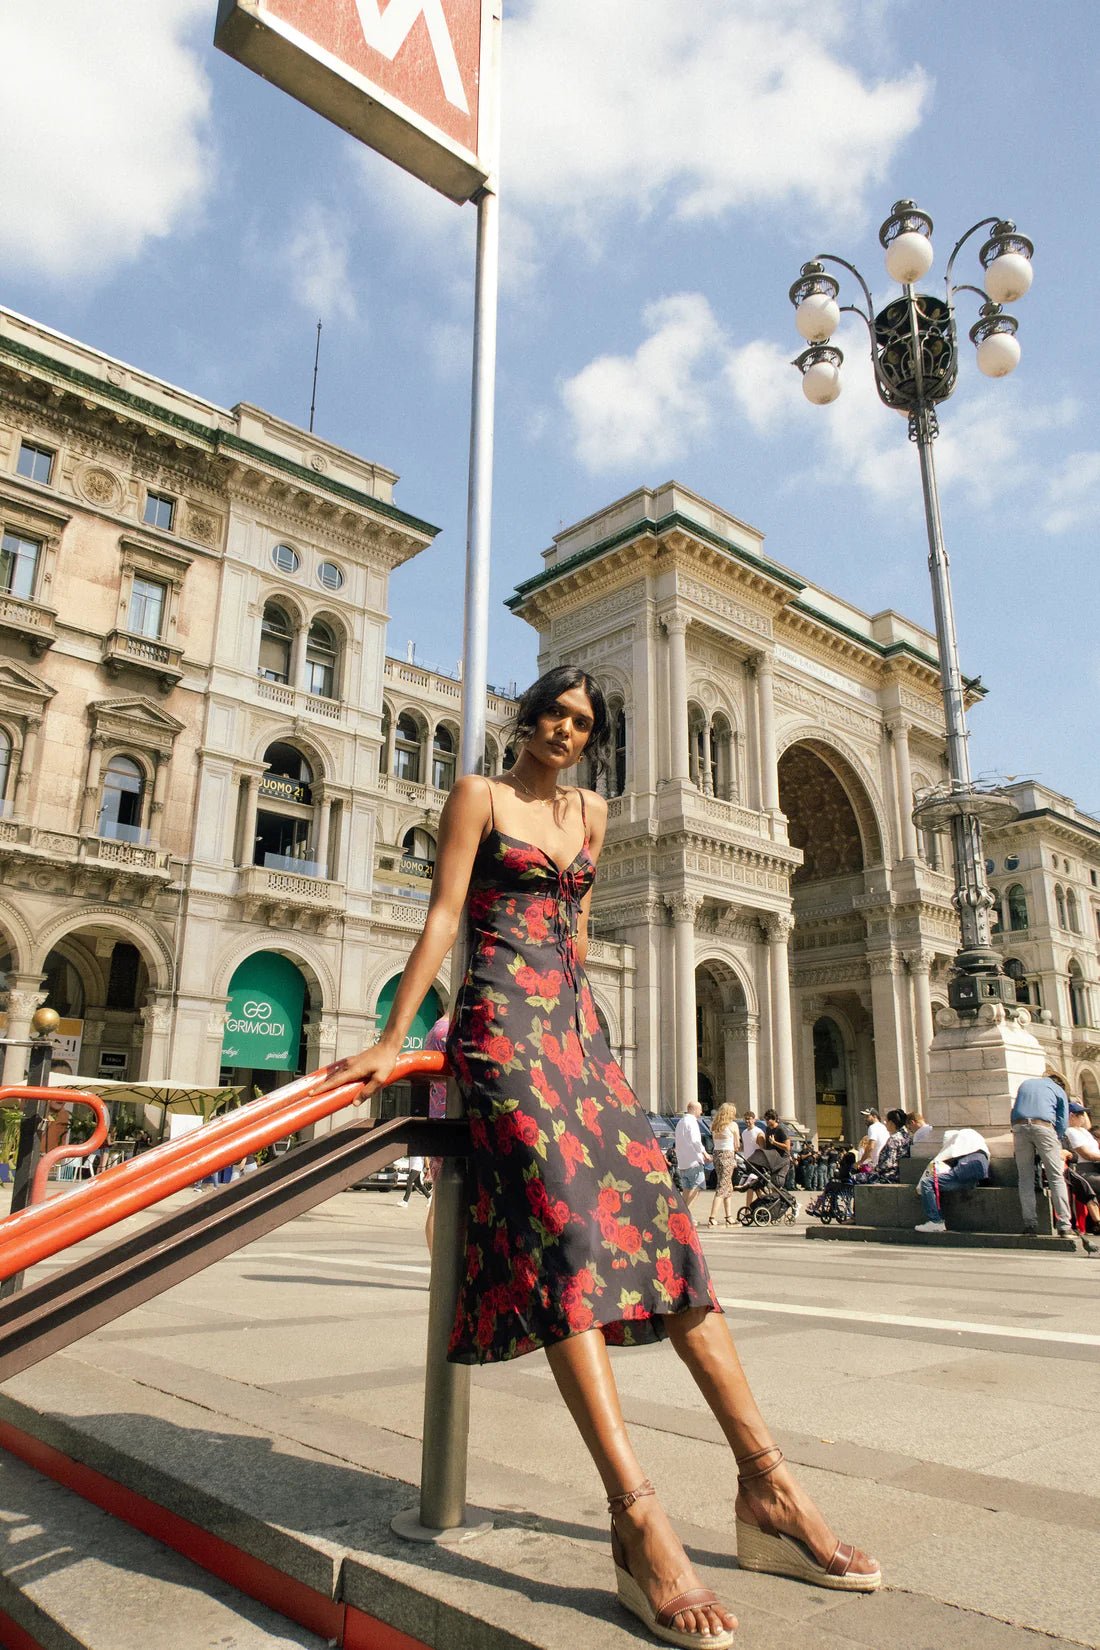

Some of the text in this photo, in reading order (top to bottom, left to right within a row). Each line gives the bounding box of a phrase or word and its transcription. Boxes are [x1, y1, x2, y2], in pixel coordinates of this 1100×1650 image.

[294, 786, 304, 796] 21
[425, 865, 433, 874] 21
[226, 1019, 285, 1036] GRIMOLDI
